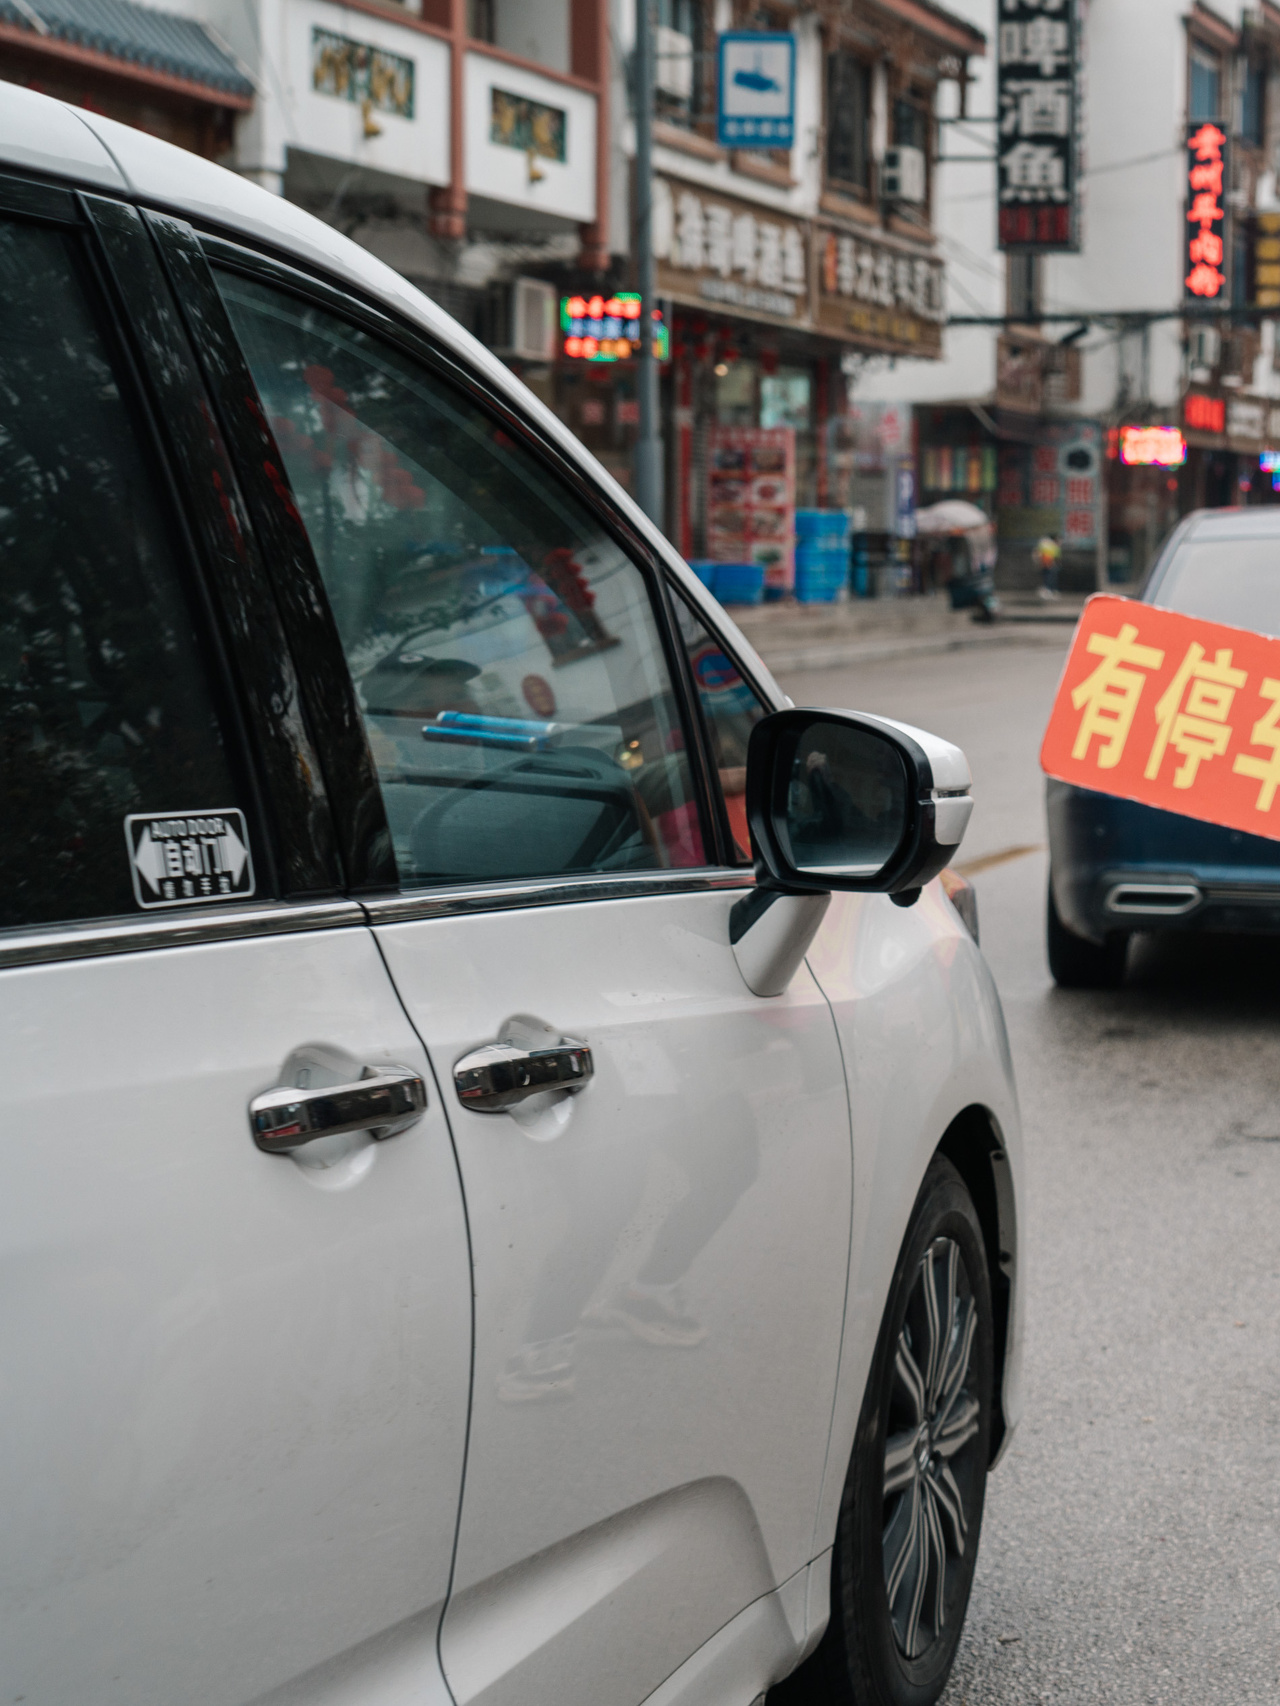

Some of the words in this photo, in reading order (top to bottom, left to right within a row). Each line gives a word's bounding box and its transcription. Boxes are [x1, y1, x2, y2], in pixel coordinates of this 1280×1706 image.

[999, 0, 1069, 203] 啤酒魚
[151, 819, 187, 838] AUTO
[187, 817, 226, 836] DOOR
[164, 837, 224, 877] 自动门
